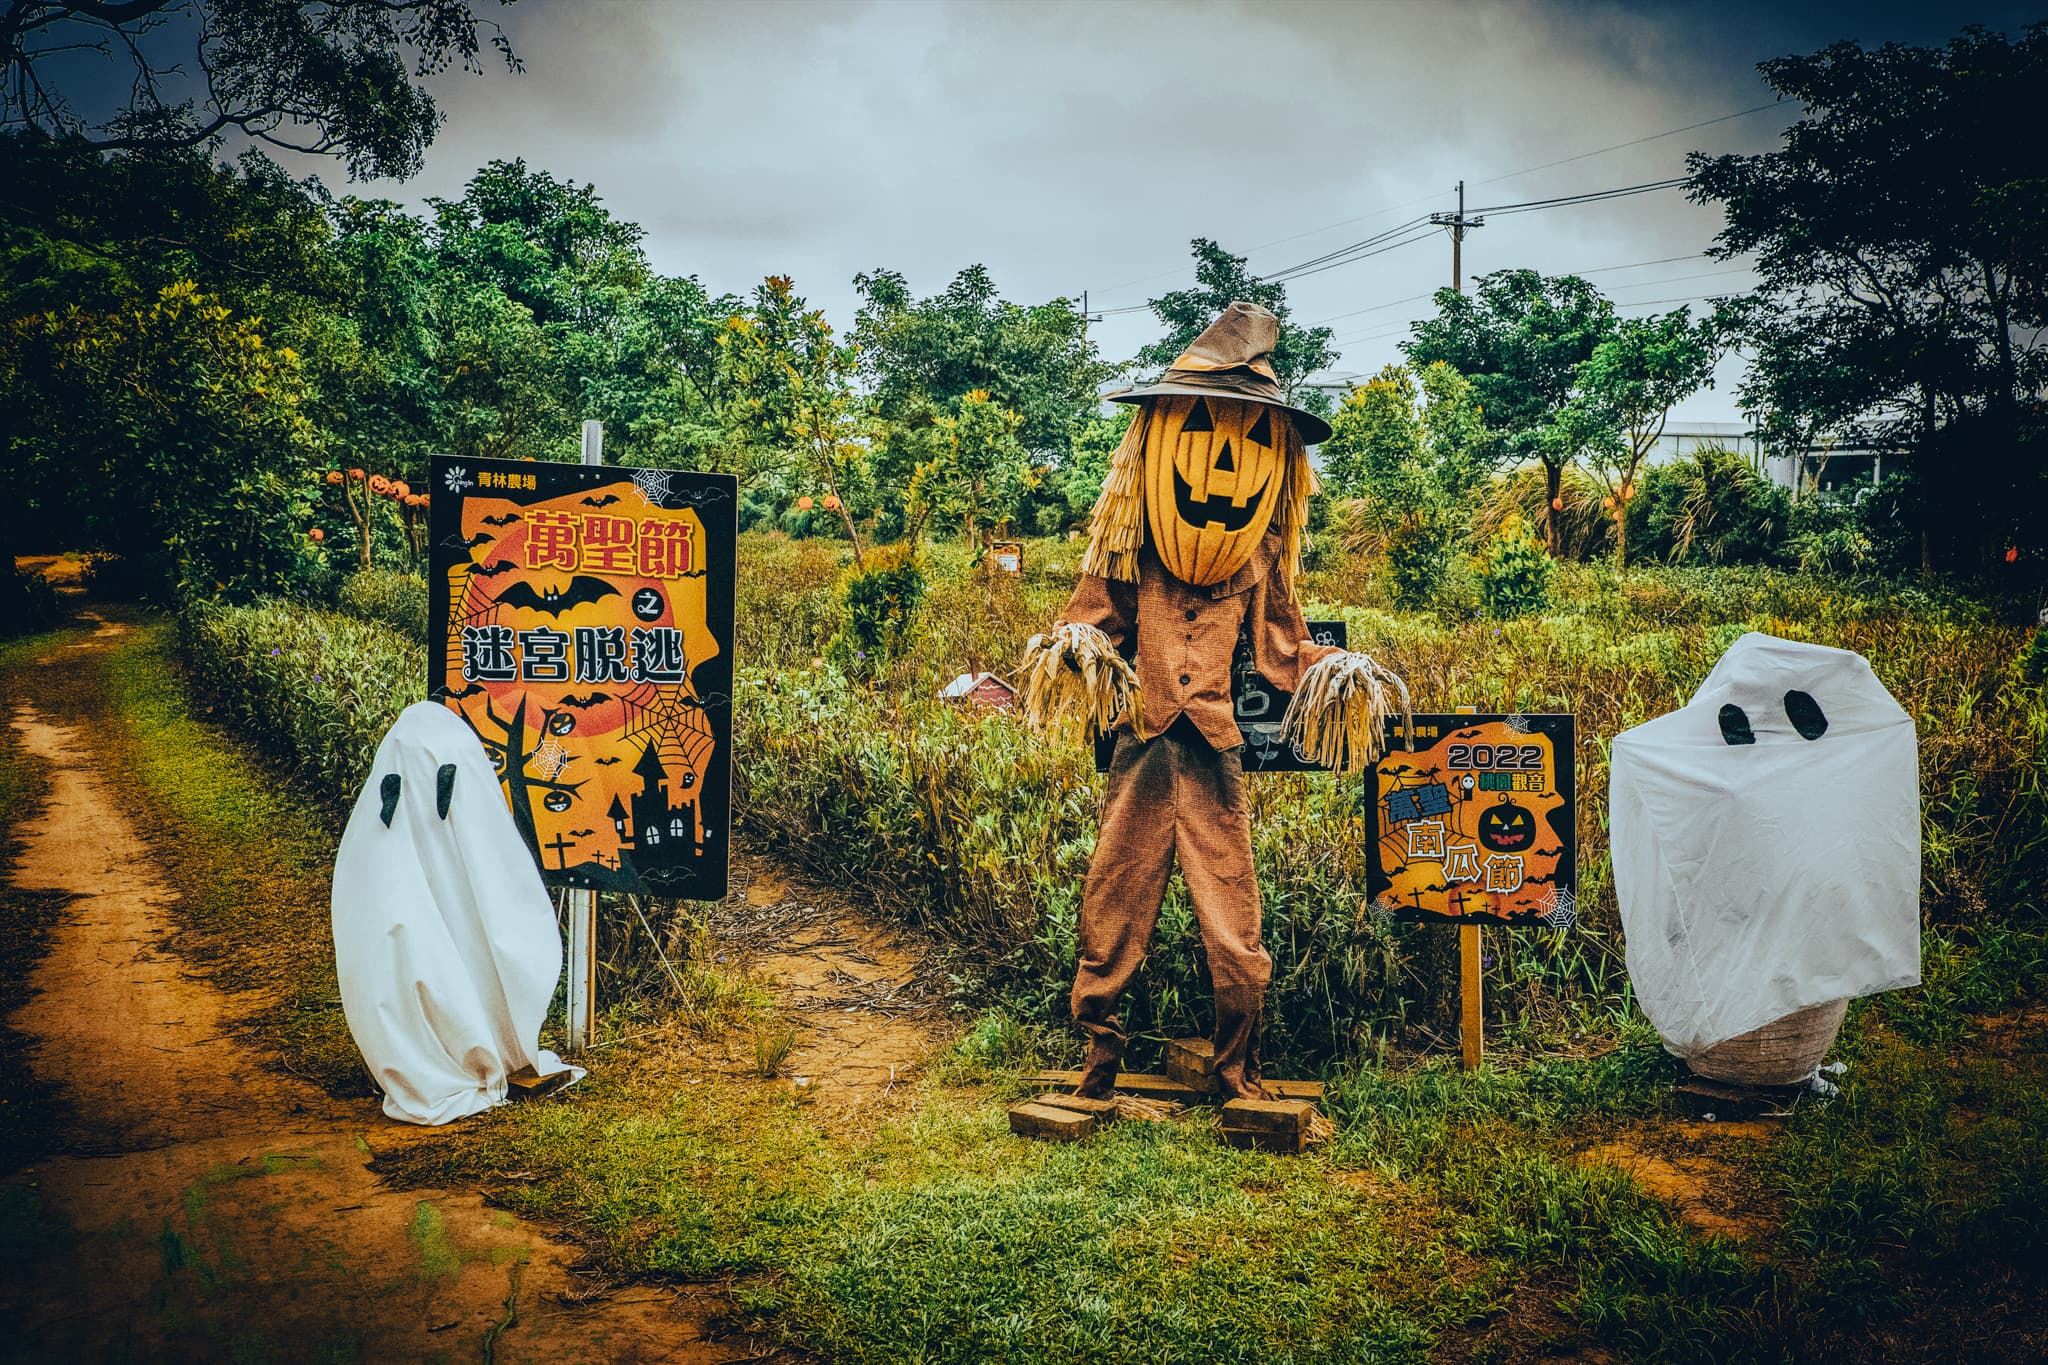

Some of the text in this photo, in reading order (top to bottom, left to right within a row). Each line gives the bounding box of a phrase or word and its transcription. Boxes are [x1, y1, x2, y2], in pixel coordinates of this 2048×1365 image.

[477, 471, 537, 491] 青林農場
[523, 509, 694, 580] 萬聖節
[636, 592, 659, 615] 之
[1448, 744, 1543, 770] 2022
[1478, 772, 1546, 792] 桃園觀音
[1384, 783, 1453, 823] 萬聖
[1406, 820, 1525, 895] 南瓜節
